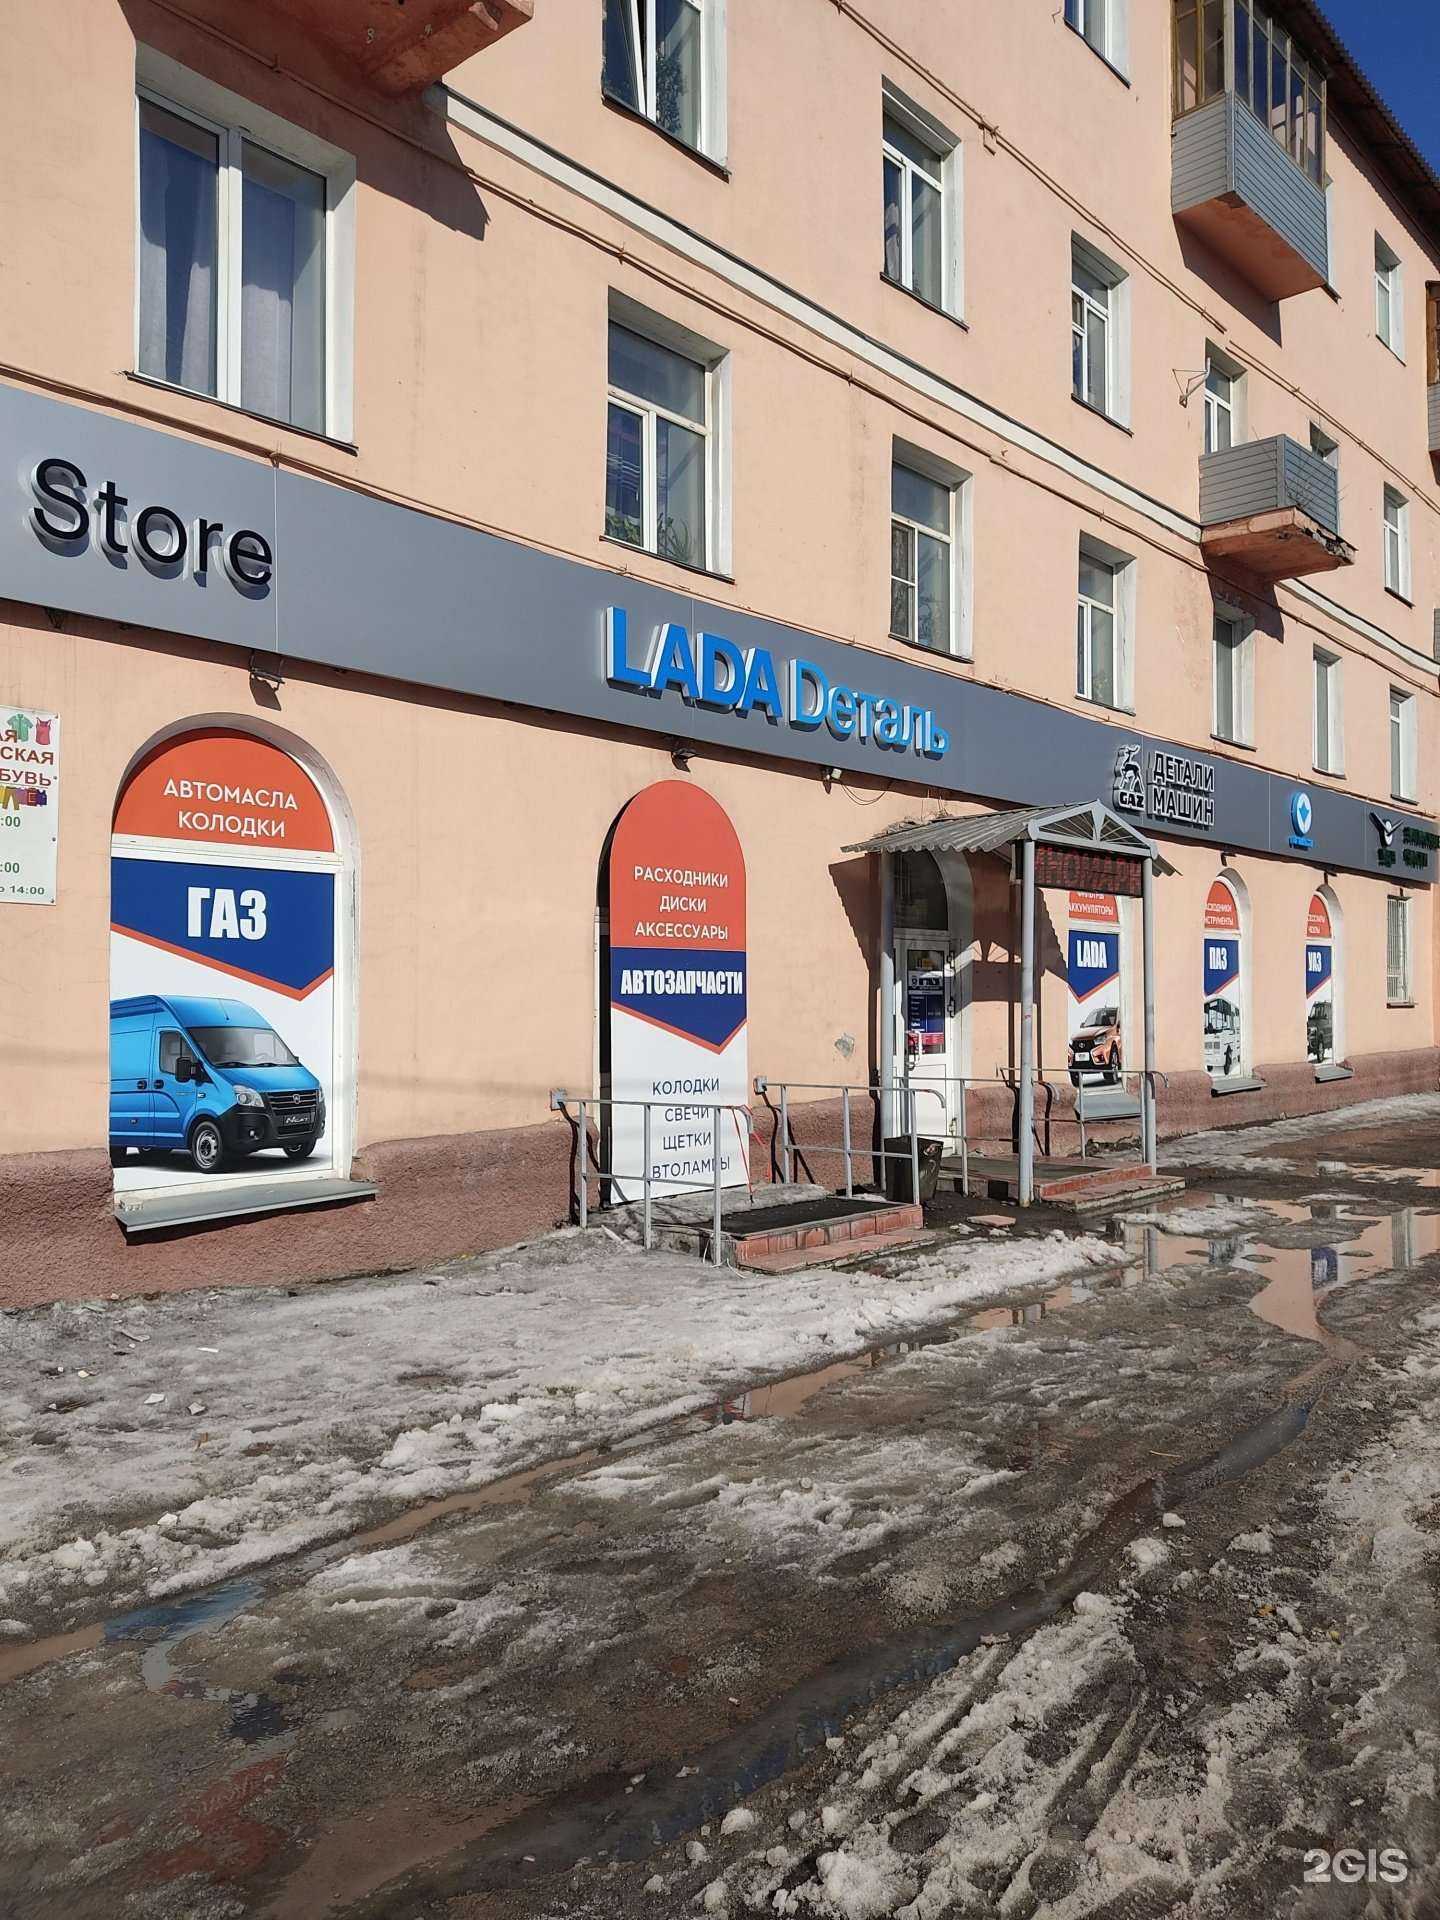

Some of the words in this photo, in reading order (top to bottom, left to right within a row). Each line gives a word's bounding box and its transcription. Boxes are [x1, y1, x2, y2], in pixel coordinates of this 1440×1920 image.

[33, 458, 272, 585] Store
[606, 606, 782, 718] LADA
[1, 746, 54, 766] СКАЯ
[1152, 751, 1215, 792] ДЕТАЛИ
[163, 778, 298, 810] АВТОМАСЛА
[1119, 791, 1145, 810] GAZ
[1152, 785, 1215, 826] МАШИН
[178, 811, 286, 838] КОЛОДКИ
[634, 866, 728, 888] РАСХОДНИКИ
[9, 886, 45, 896] 14:00
[187, 886, 267, 940] ГАЗ
[660, 896, 707, 913] ДИСКИ
[635, 922, 728, 940] АКСЕССУАРЫ
[1076, 939, 1108, 969] LADA
[1209, 946, 1228, 971] ПАЗ
[620, 969, 743, 996] АВТОЗАПЧАСТИ
[652, 1078, 720, 1096] КОЛОДКИ
[664, 1106, 710, 1122] СВЕЧИ
[662, 1132, 711, 1151] ЩЕТКИ
[643, 1156, 730, 1179] ВТОЛАМЫ
